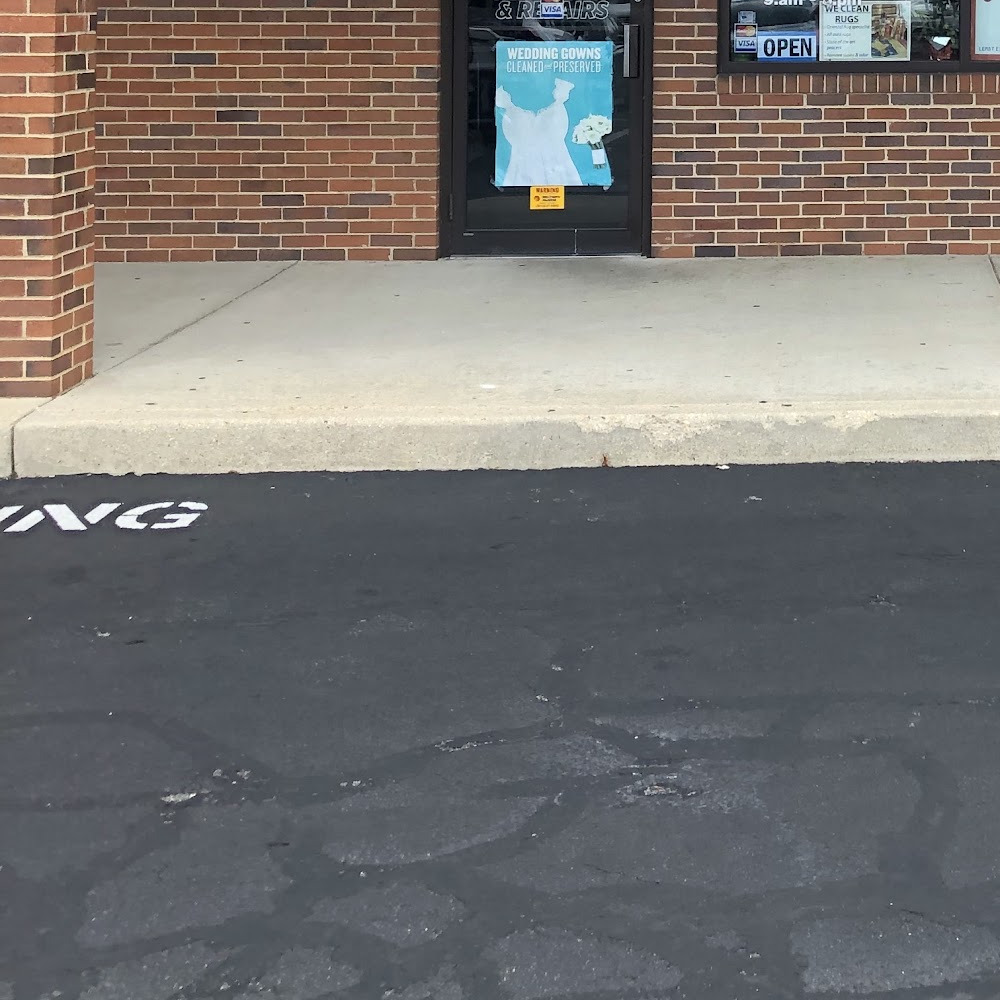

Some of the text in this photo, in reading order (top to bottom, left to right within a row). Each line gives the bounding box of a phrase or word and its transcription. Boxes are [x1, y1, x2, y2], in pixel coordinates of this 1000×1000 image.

[495, 1, 609, 20] & REAIRS
[840, 4, 869, 13] CLEAN
[835, 15, 859, 24] RUGS
[507, 47, 601, 60] WEDDING GOWNS
[763, 38, 812, 57] OPEN
[506, 60, 544, 73] CLEANED
[553, 61, 601, 73] PRESERVED
